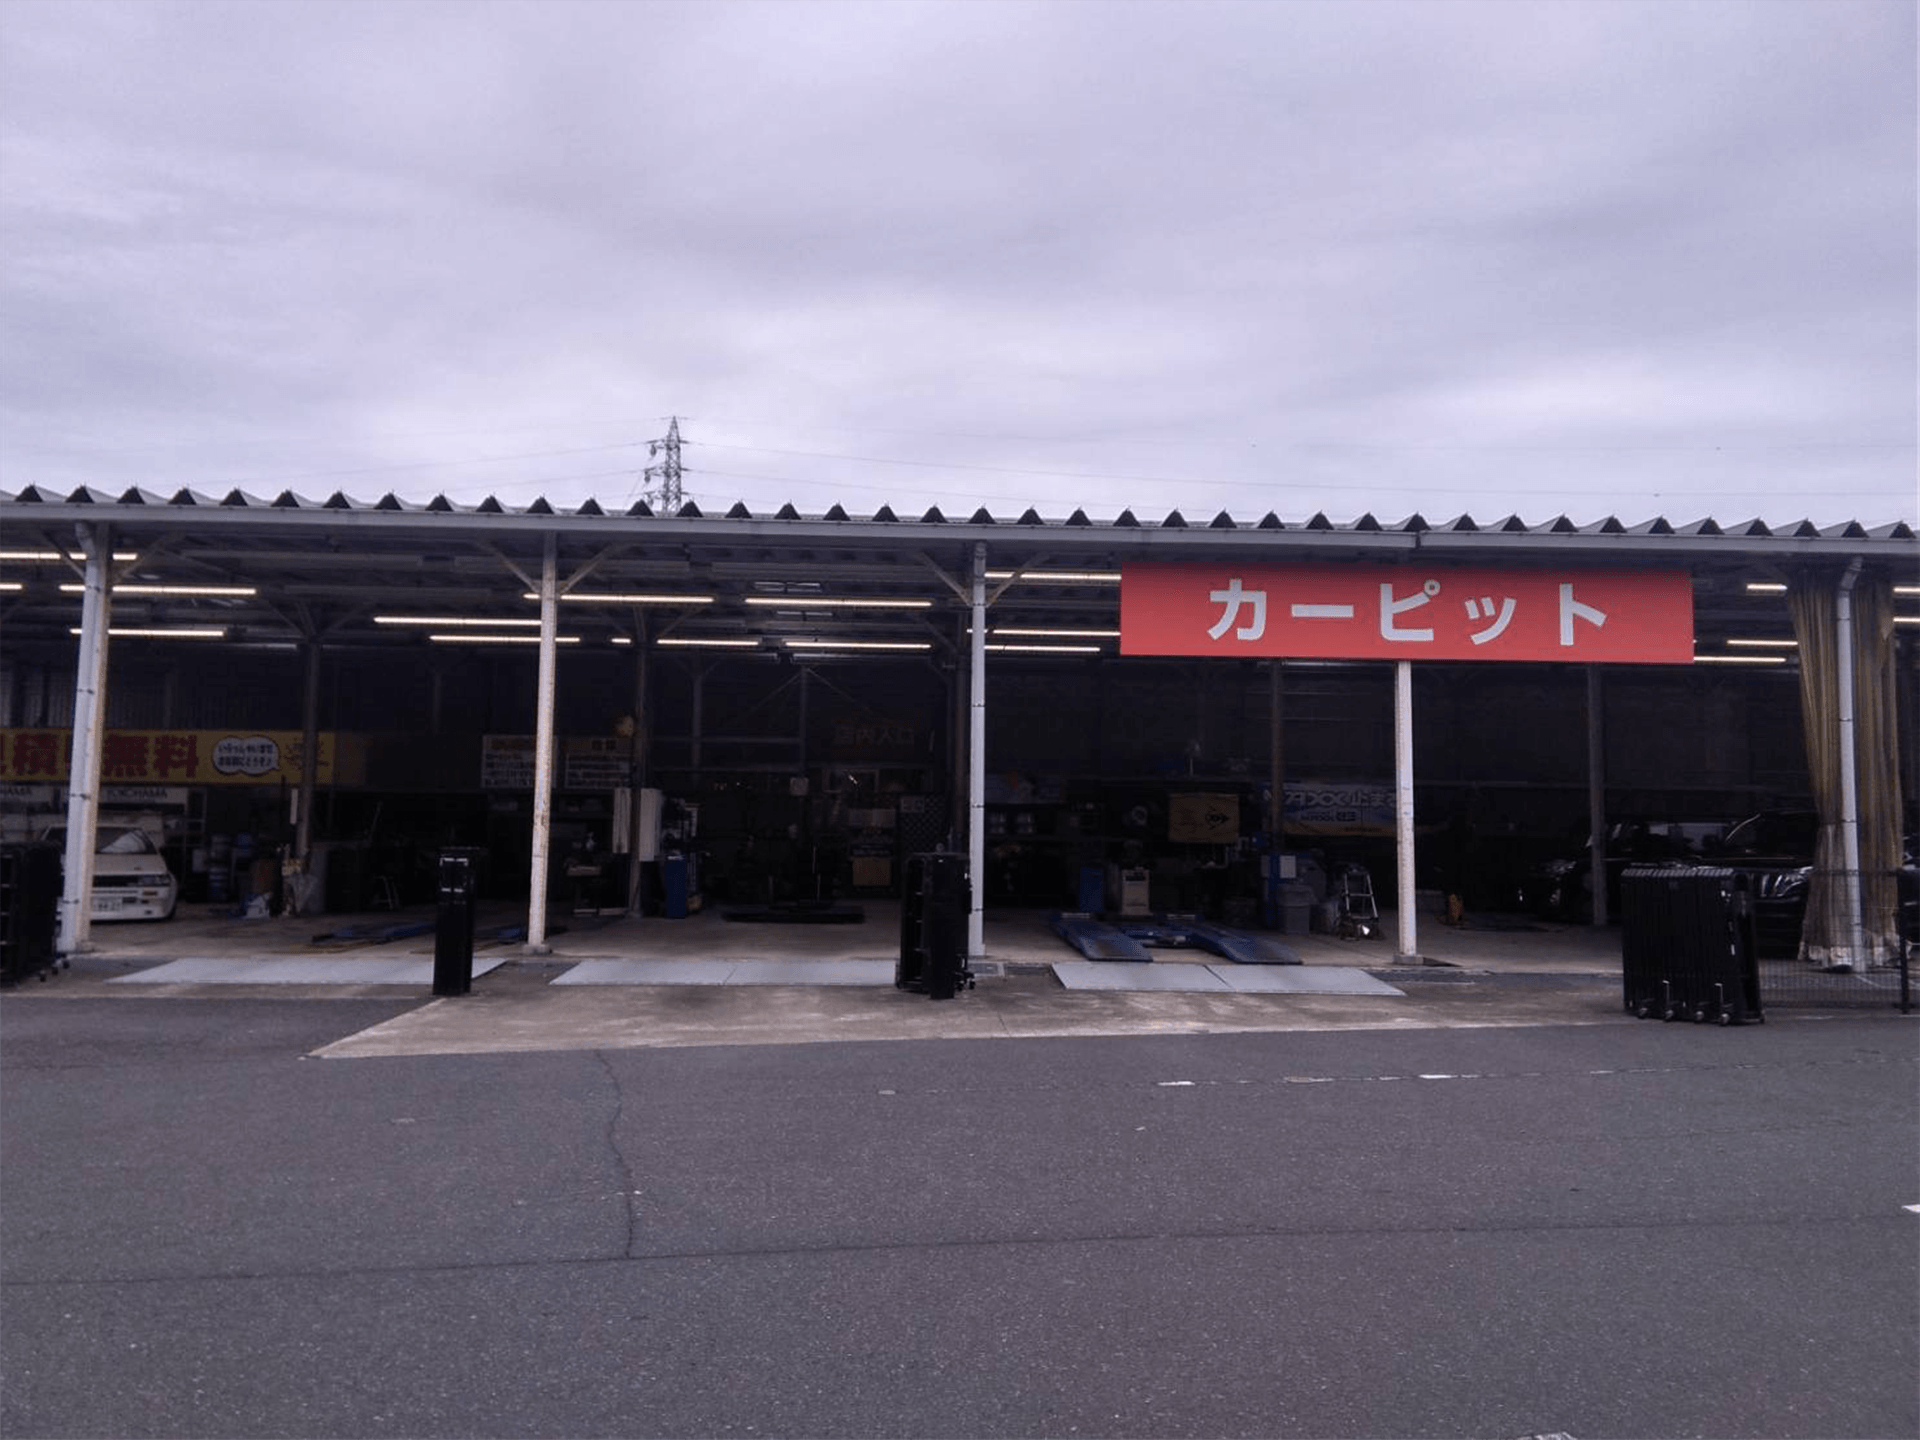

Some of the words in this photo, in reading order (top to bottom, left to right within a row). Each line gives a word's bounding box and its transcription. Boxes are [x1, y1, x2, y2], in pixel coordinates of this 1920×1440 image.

[1207, 577, 1607, 647] カーピット
[833, 725, 915, 745] 店内入口
